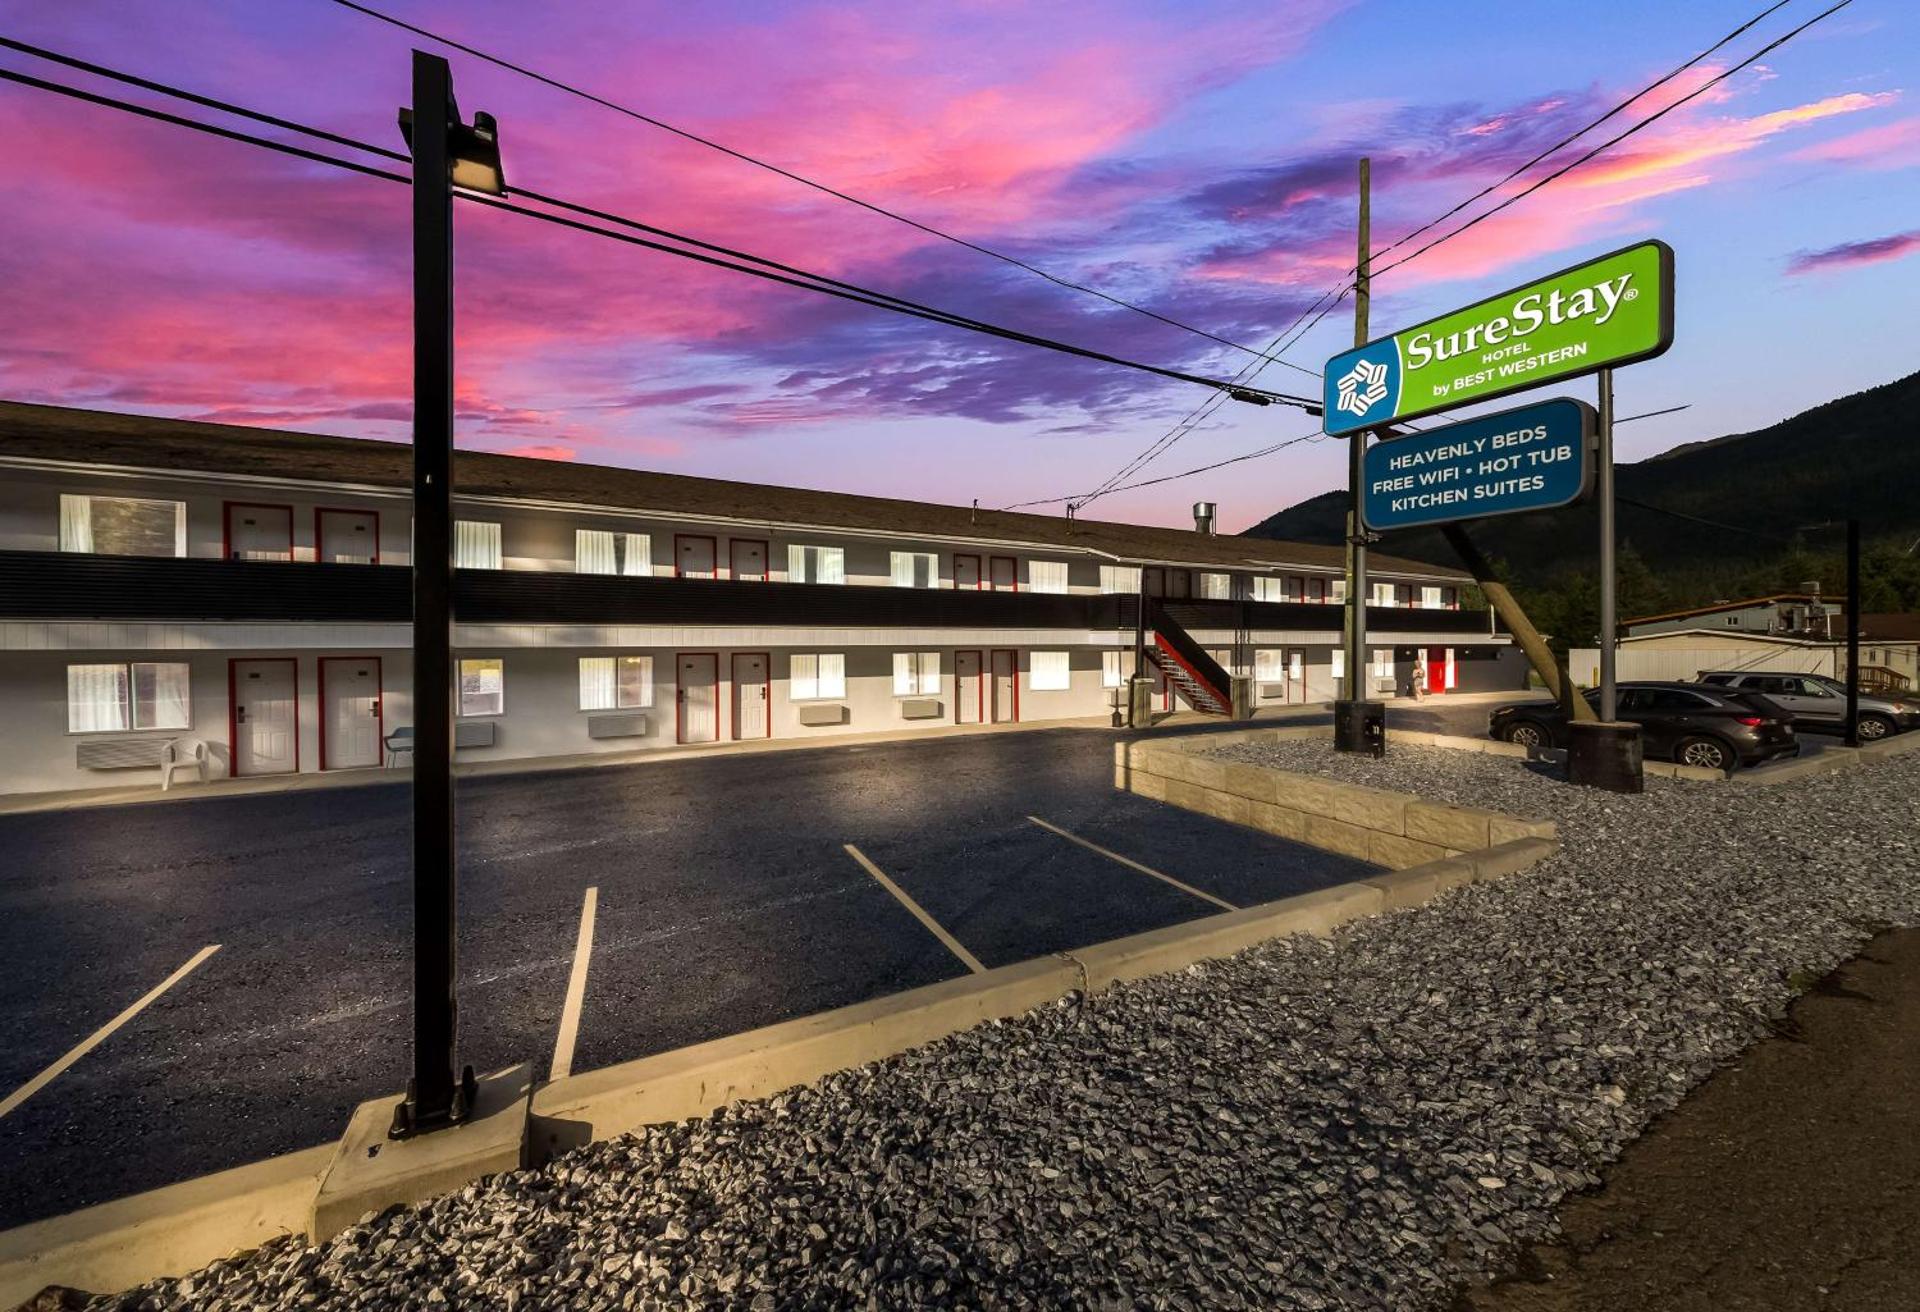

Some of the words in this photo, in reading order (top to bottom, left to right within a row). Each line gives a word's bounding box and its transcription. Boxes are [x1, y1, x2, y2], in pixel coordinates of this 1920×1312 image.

[1433, 382, 1449, 397] by
[1454, 369, 1495, 392] BEST
[1499, 343, 1588, 377] WESTERN
[1482, 342, 1531, 364] HOTEL
[1373, 476, 1414, 494] FREE
[1419, 468, 1459, 487] WIFI
[1479, 456, 1522, 476] HOT
[1528, 445, 1572, 467] TUB
[1390, 438, 1486, 471] HEAVENLY
[1492, 426, 1547, 450] BEDS
[1392, 488, 1468, 512] KITCHEN
[1474, 475, 1545, 499] SUITES
